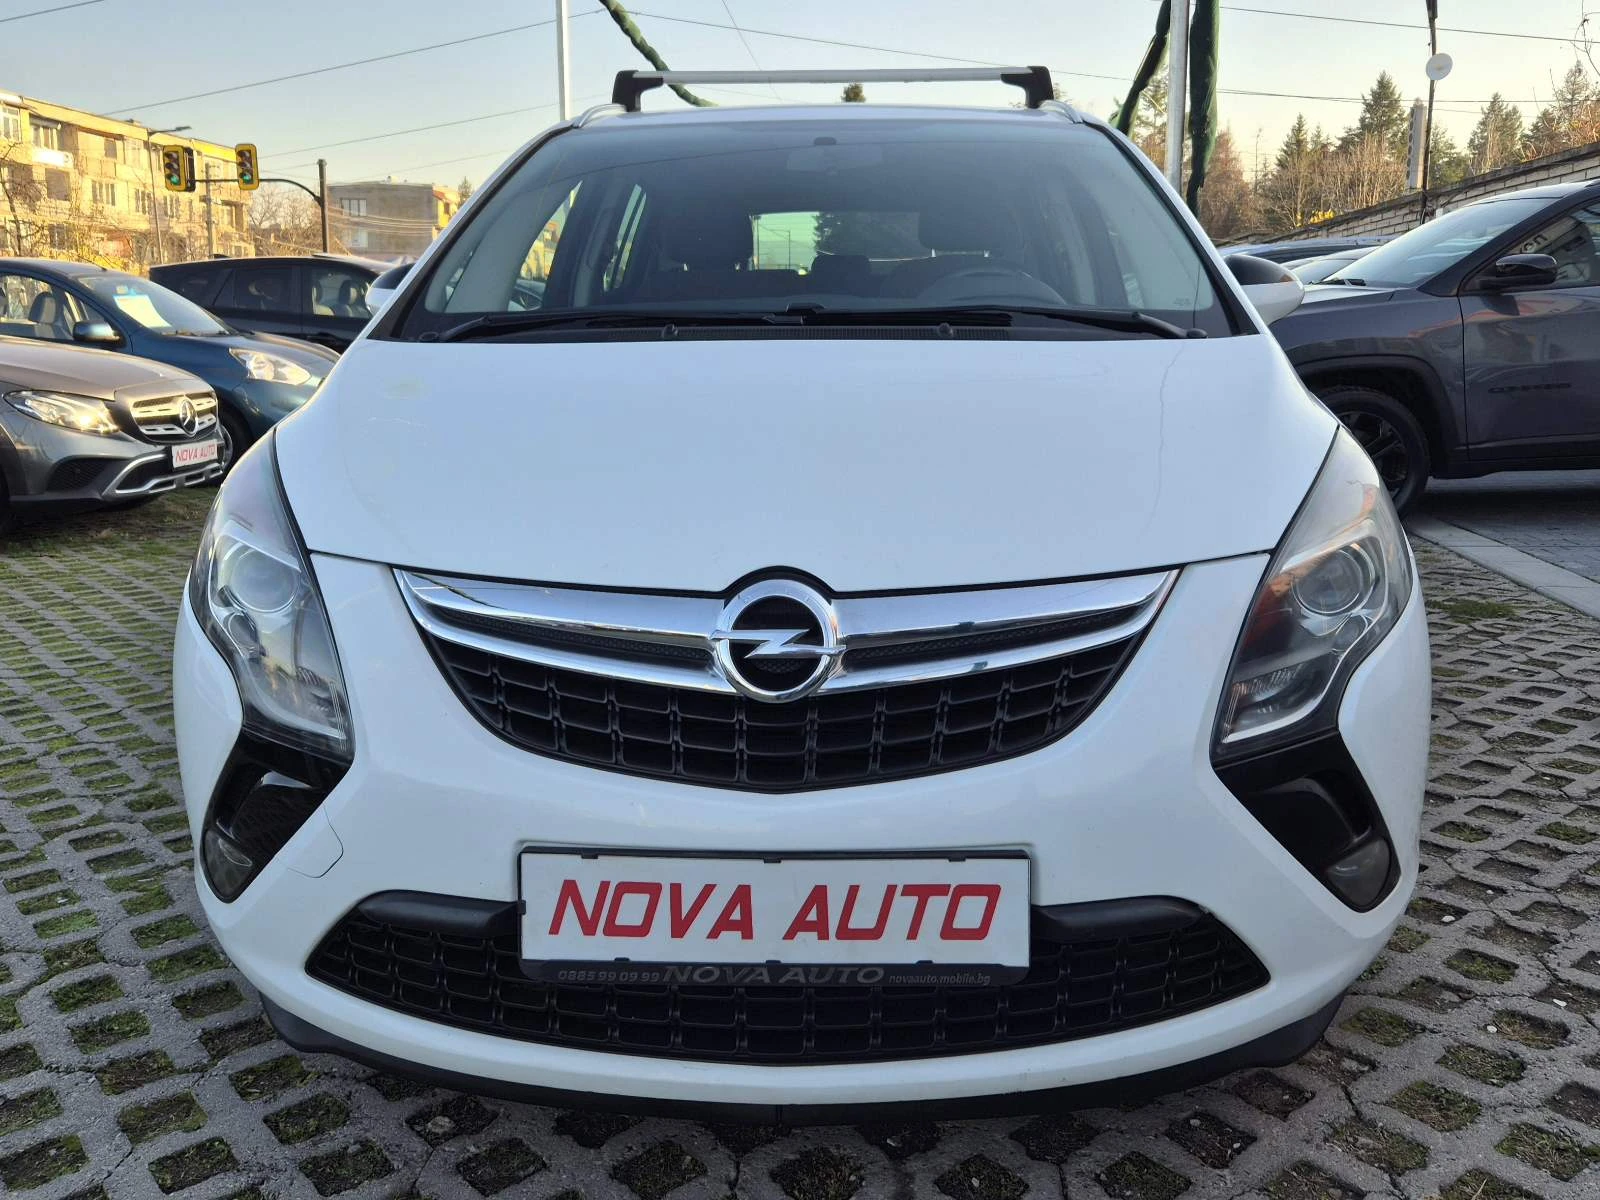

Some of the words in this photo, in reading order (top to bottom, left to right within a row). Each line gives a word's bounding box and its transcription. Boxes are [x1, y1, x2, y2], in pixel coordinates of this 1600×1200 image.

[176, 446, 198, 462] NOVA
[199, 443, 216, 459] AUTO
[548, 878, 754, 941] NOVA
[782, 884, 1002, 941] AUTO
[558, 970, 595, 981] 0885
[599, 971, 617, 982] 99
[619, 971, 639, 983] 09
[640, 971, 660, 983] 99
[662, 965, 771, 984] NOVA
[778, 966, 885, 984] AUTO
